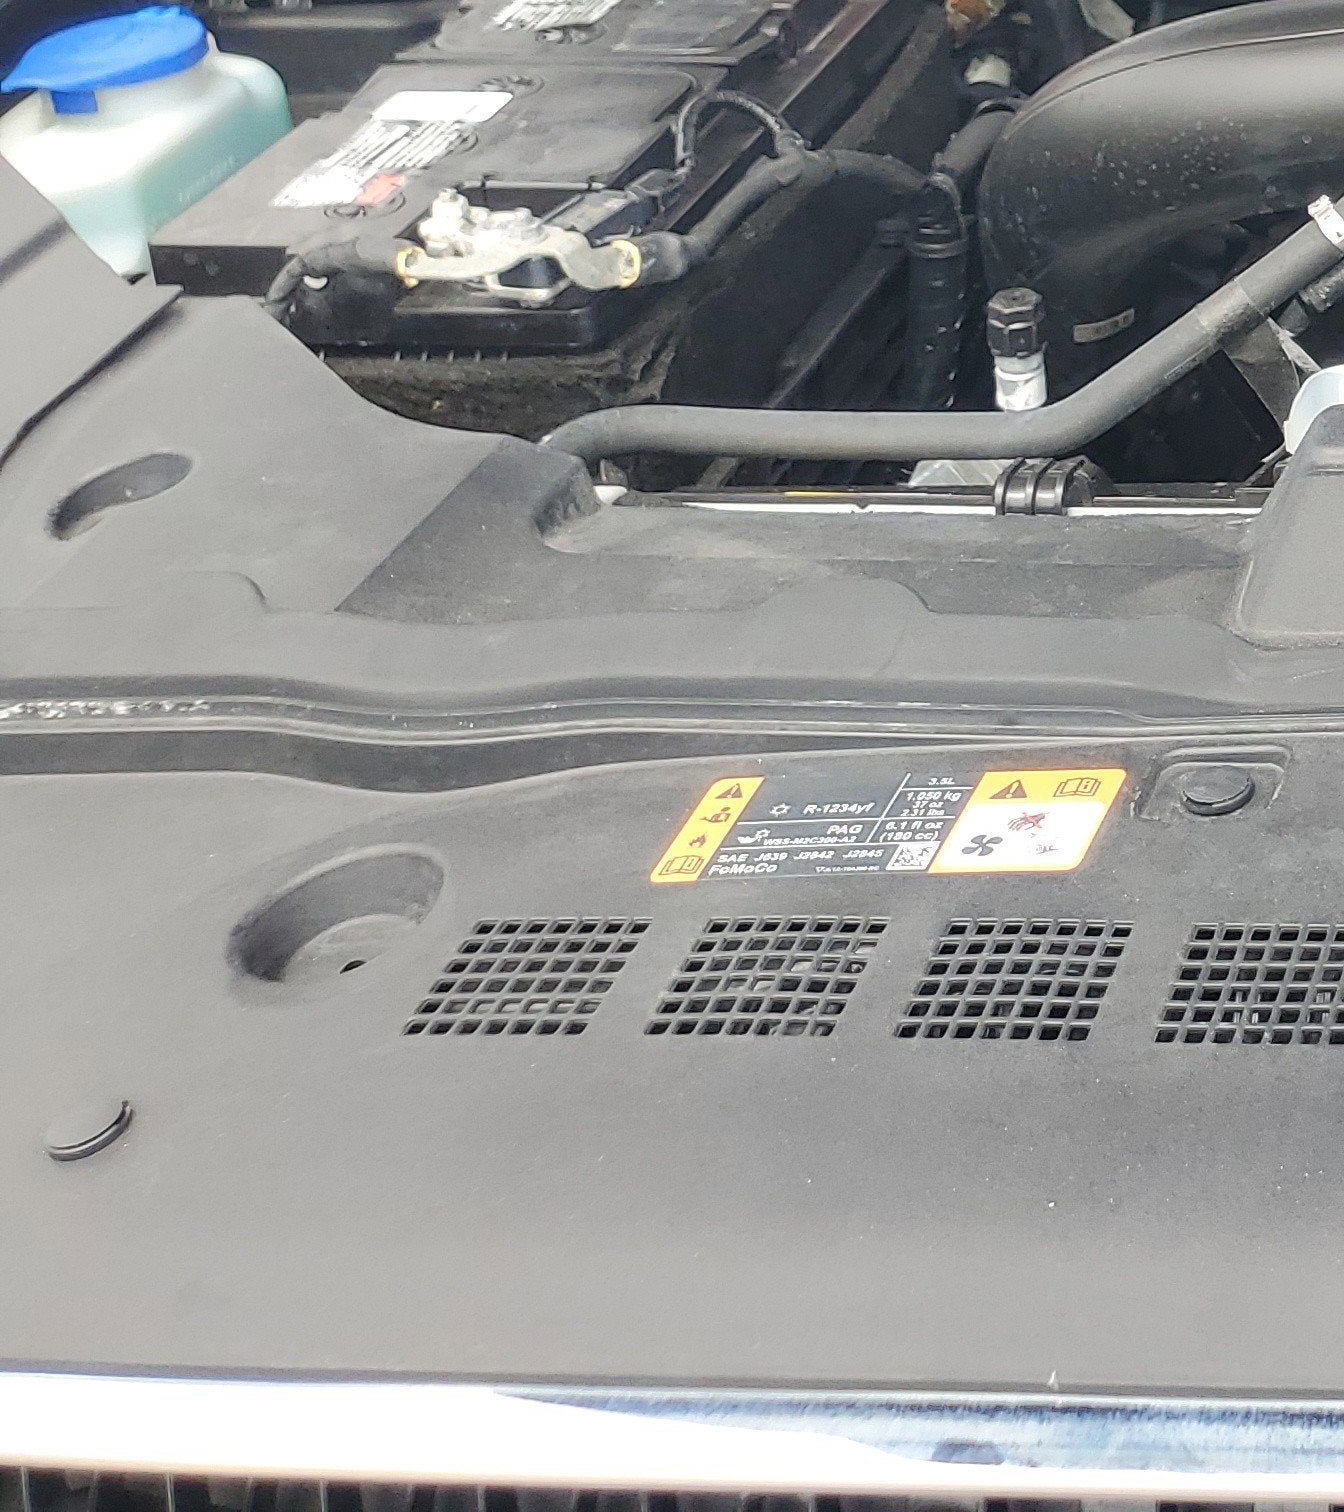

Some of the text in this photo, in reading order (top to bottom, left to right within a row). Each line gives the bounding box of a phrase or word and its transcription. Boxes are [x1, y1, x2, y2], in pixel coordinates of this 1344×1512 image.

[928, 777, 955, 786] 3.5L
[943, 790, 962, 801] kg
[803, 802, 876, 814] R-1234yf
[912, 800, 928, 808] 37
[900, 808, 945, 817] 2.31 lbs
[827, 824, 864, 835] PAG
[910, 820, 923, 830] fl
[924, 821, 944, 829] oz
[880, 830, 938, 843] (180 cc)
[717, 849, 884, 863] SAE J639 J2842 J2845
[708, 862, 778, 876] FoMoCo
